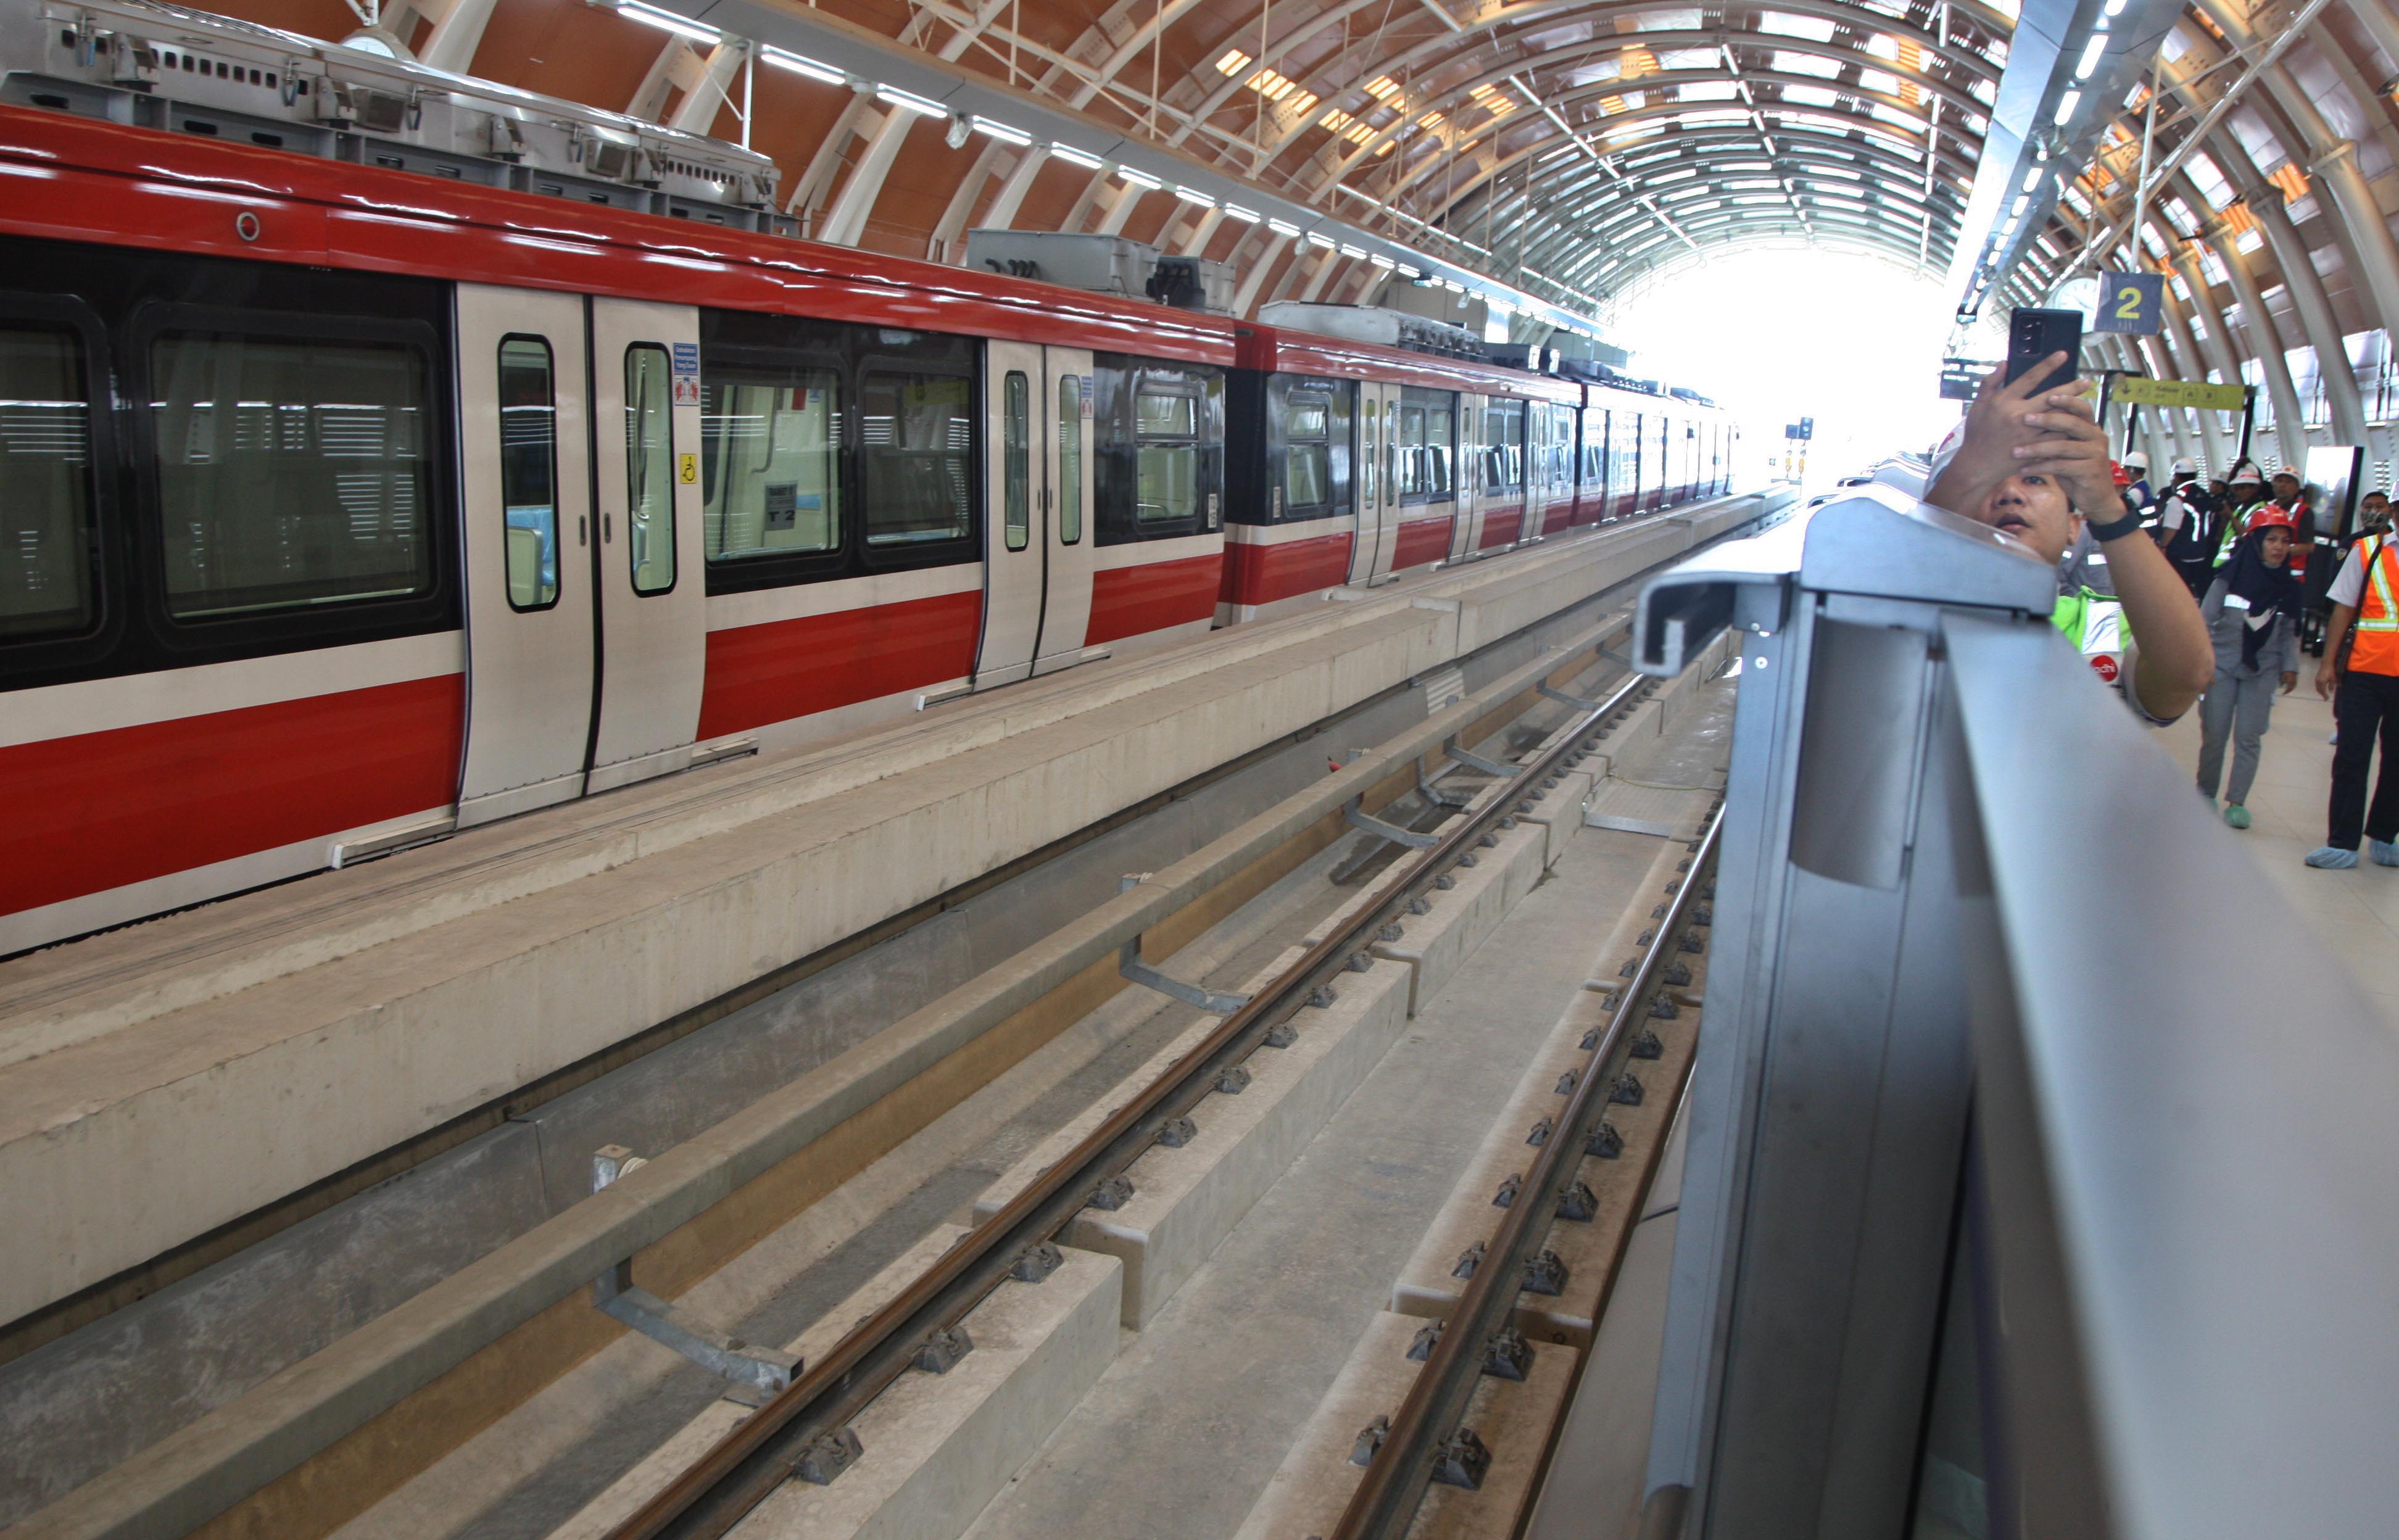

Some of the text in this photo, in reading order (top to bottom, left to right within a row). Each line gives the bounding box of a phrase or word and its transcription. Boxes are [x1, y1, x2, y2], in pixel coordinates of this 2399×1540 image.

[2115, 286, 2142, 320] 2
[768, 510, 795, 522] T 2
